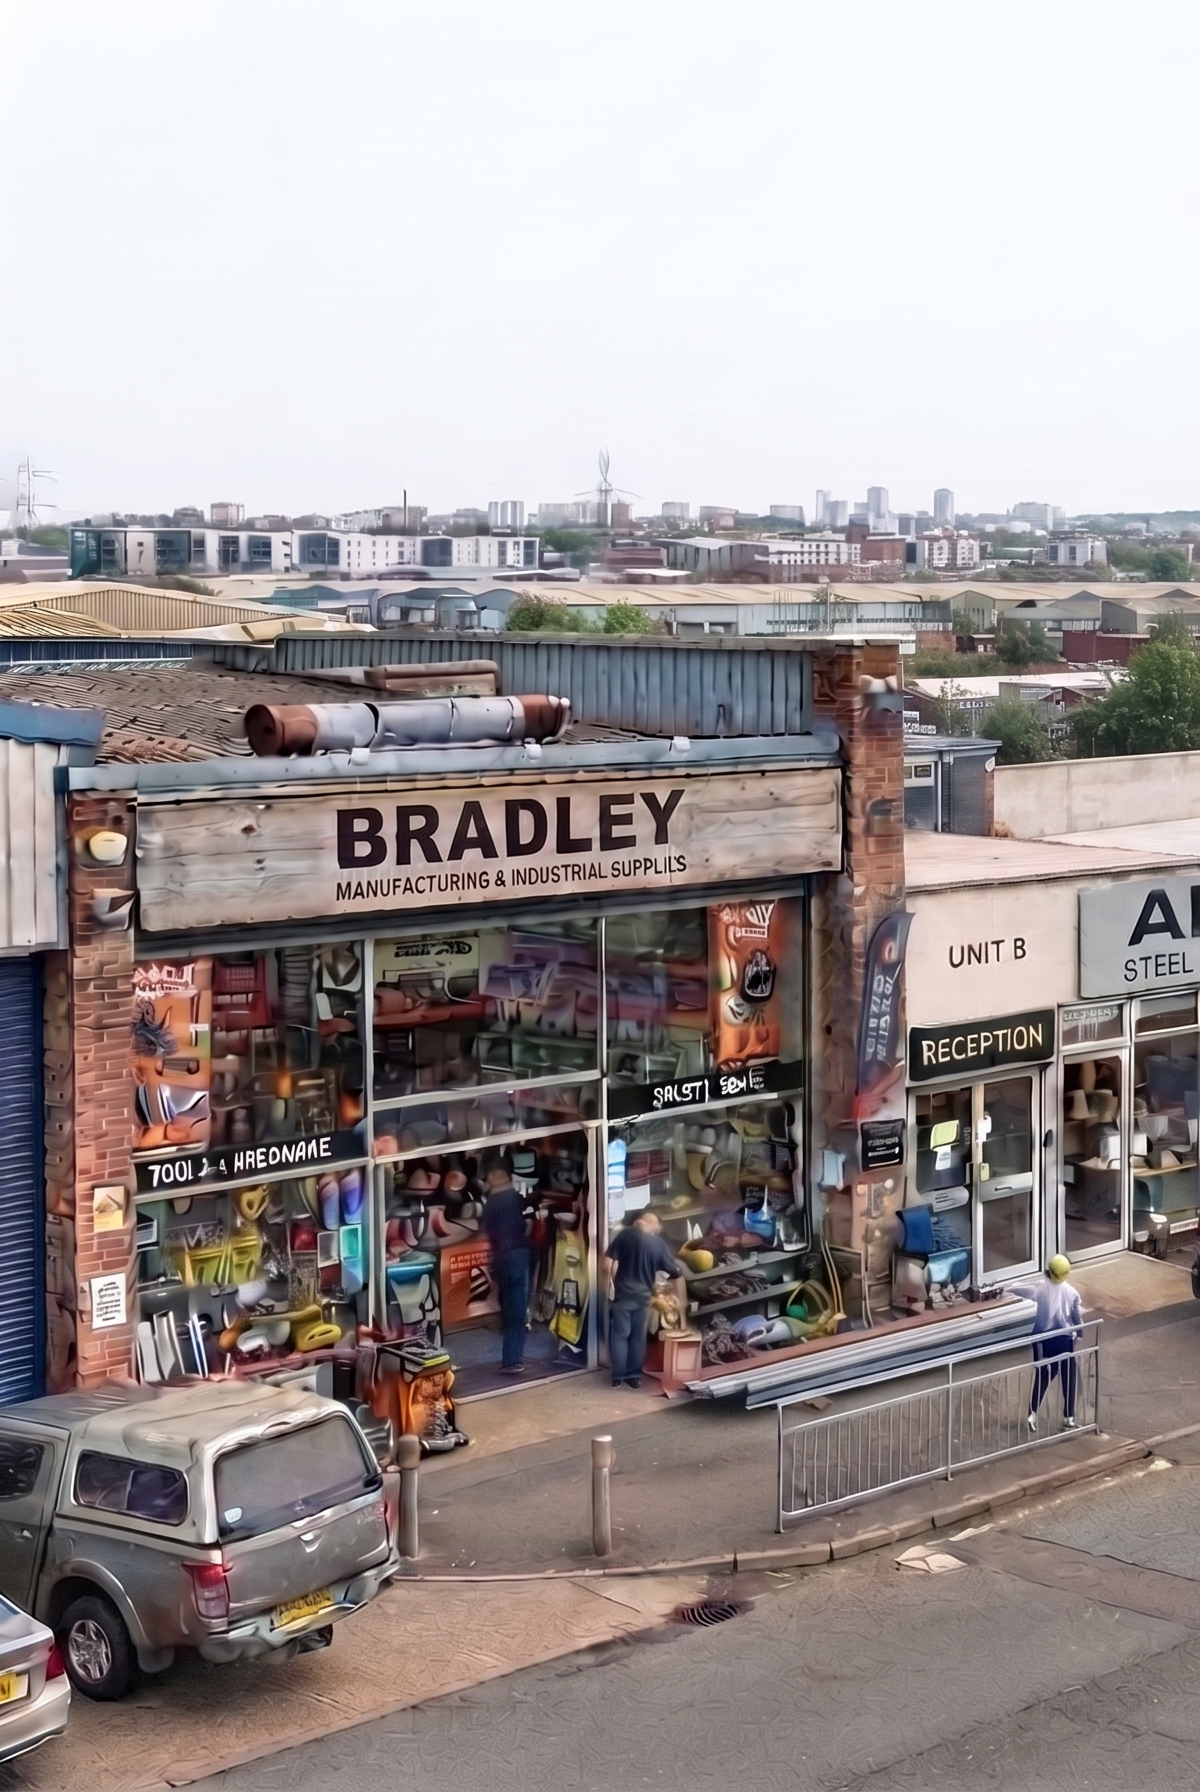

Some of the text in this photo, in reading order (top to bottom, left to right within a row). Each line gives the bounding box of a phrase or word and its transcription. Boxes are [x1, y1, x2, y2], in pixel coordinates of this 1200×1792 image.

[336, 789, 686, 870] BRADLEY
[336, 870, 490, 901] MANUFACTURING
[494, 871, 507, 888] &
[511, 862, 608, 886] INDUSTRIAL
[949, 937, 1027, 968] UNIT B
[1124, 951, 1194, 982] STEEL
[921, 1023, 1043, 1066] RECEPTION
